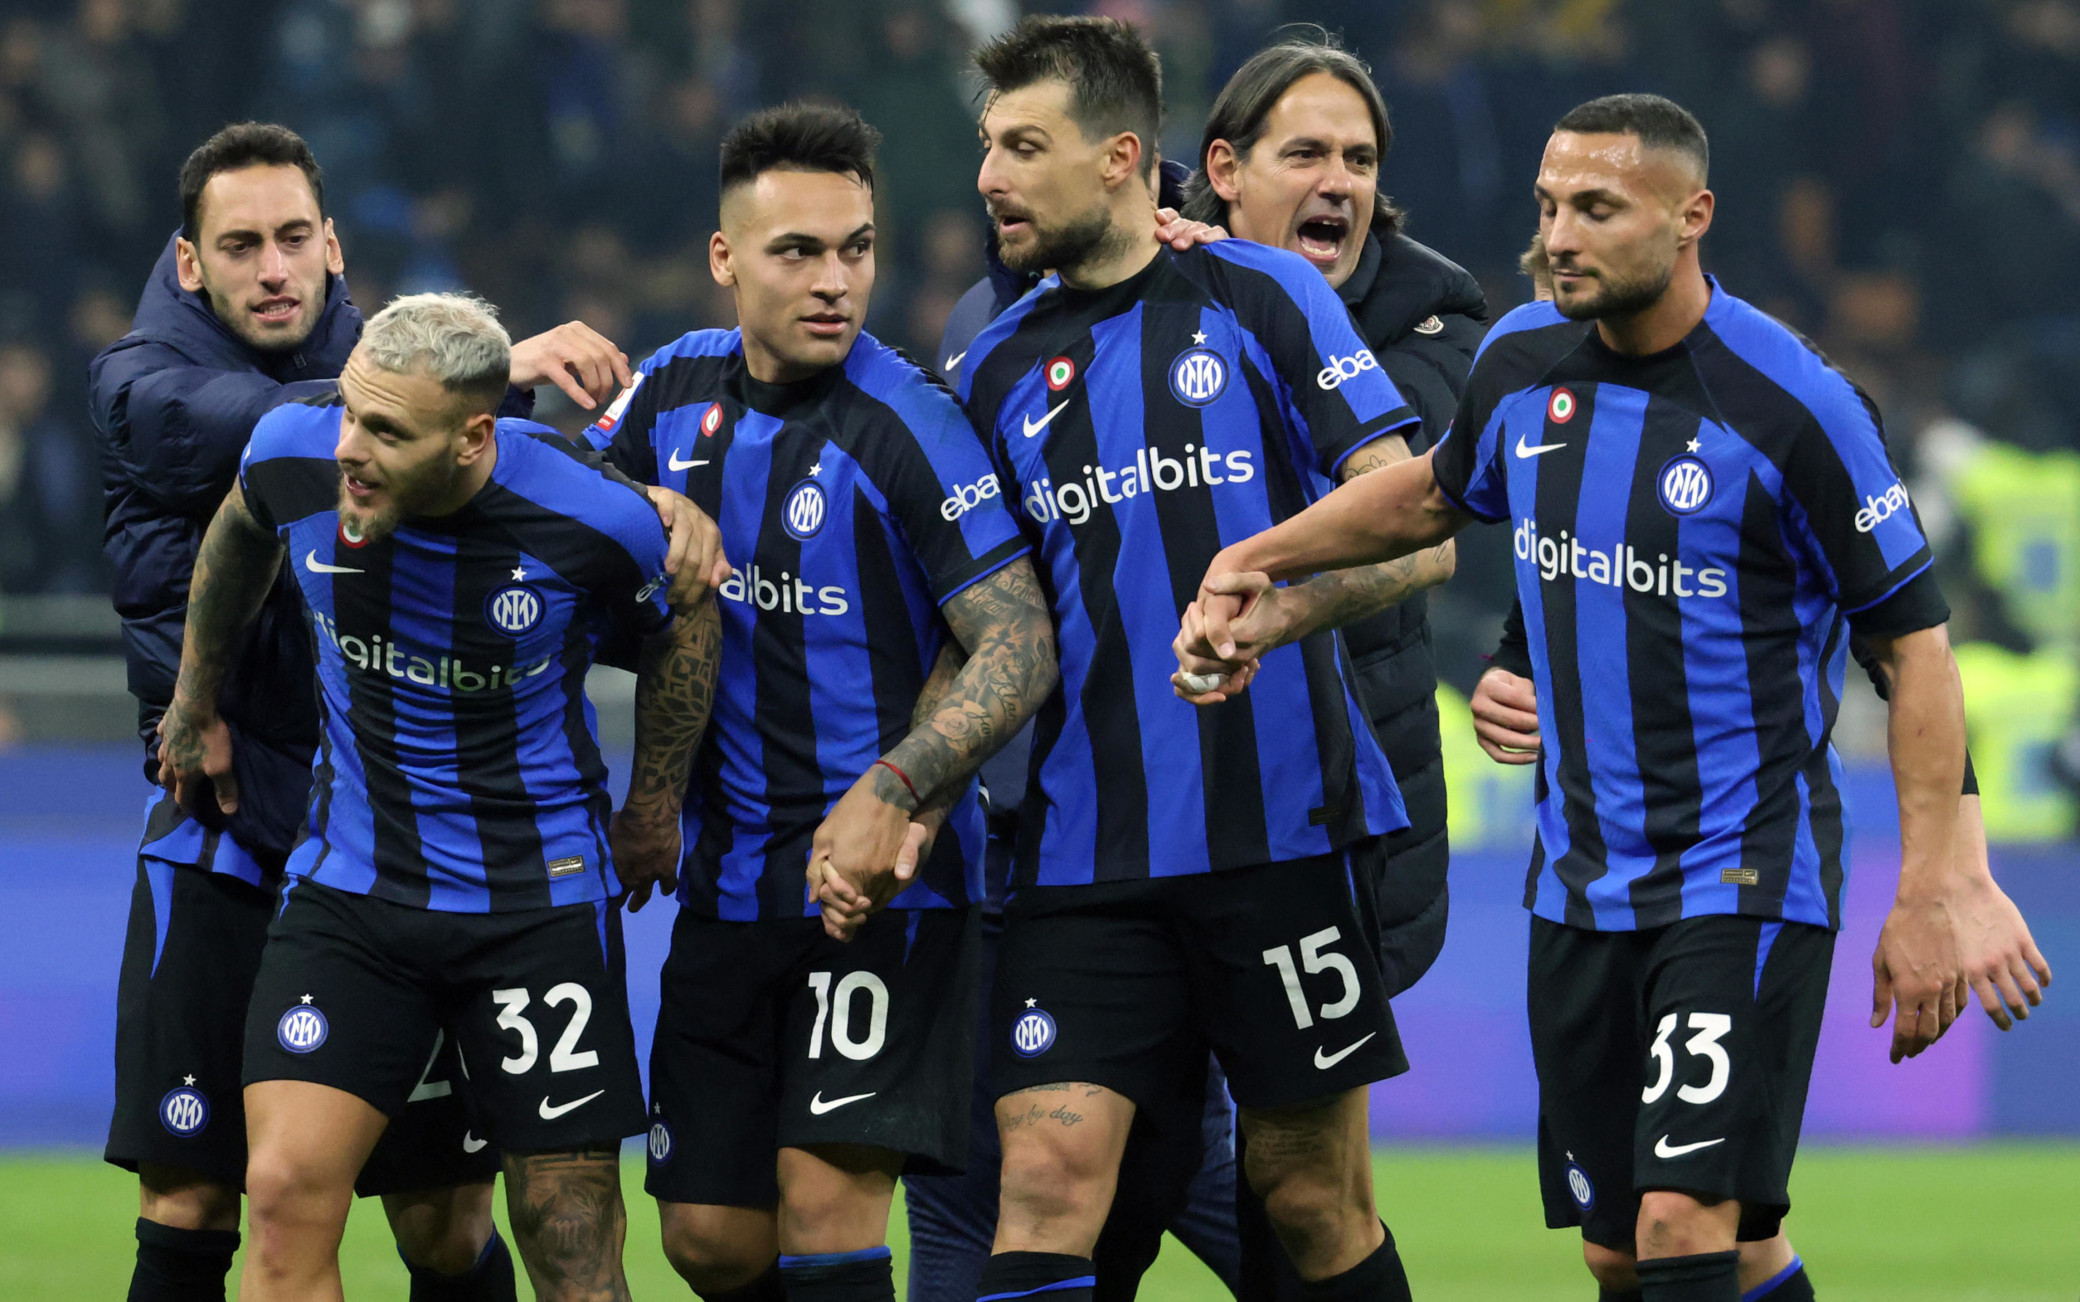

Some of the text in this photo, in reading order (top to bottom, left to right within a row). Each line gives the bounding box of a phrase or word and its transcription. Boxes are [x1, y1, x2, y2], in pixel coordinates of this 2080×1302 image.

[1316, 348, 1380, 391] eba
[940, 472, 1002, 522] eba
[1024, 443, 1255, 525] digitalbits
[1854, 477, 1910, 533] ebay
[718, 562, 849, 616] albits
[1513, 517, 1727, 599] digitalbits
[807, 970, 890, 1061] 10
[1262, 925, 1362, 1030] 15
[492, 982, 599, 1076] 32
[1641, 1012, 1732, 1105] 33
